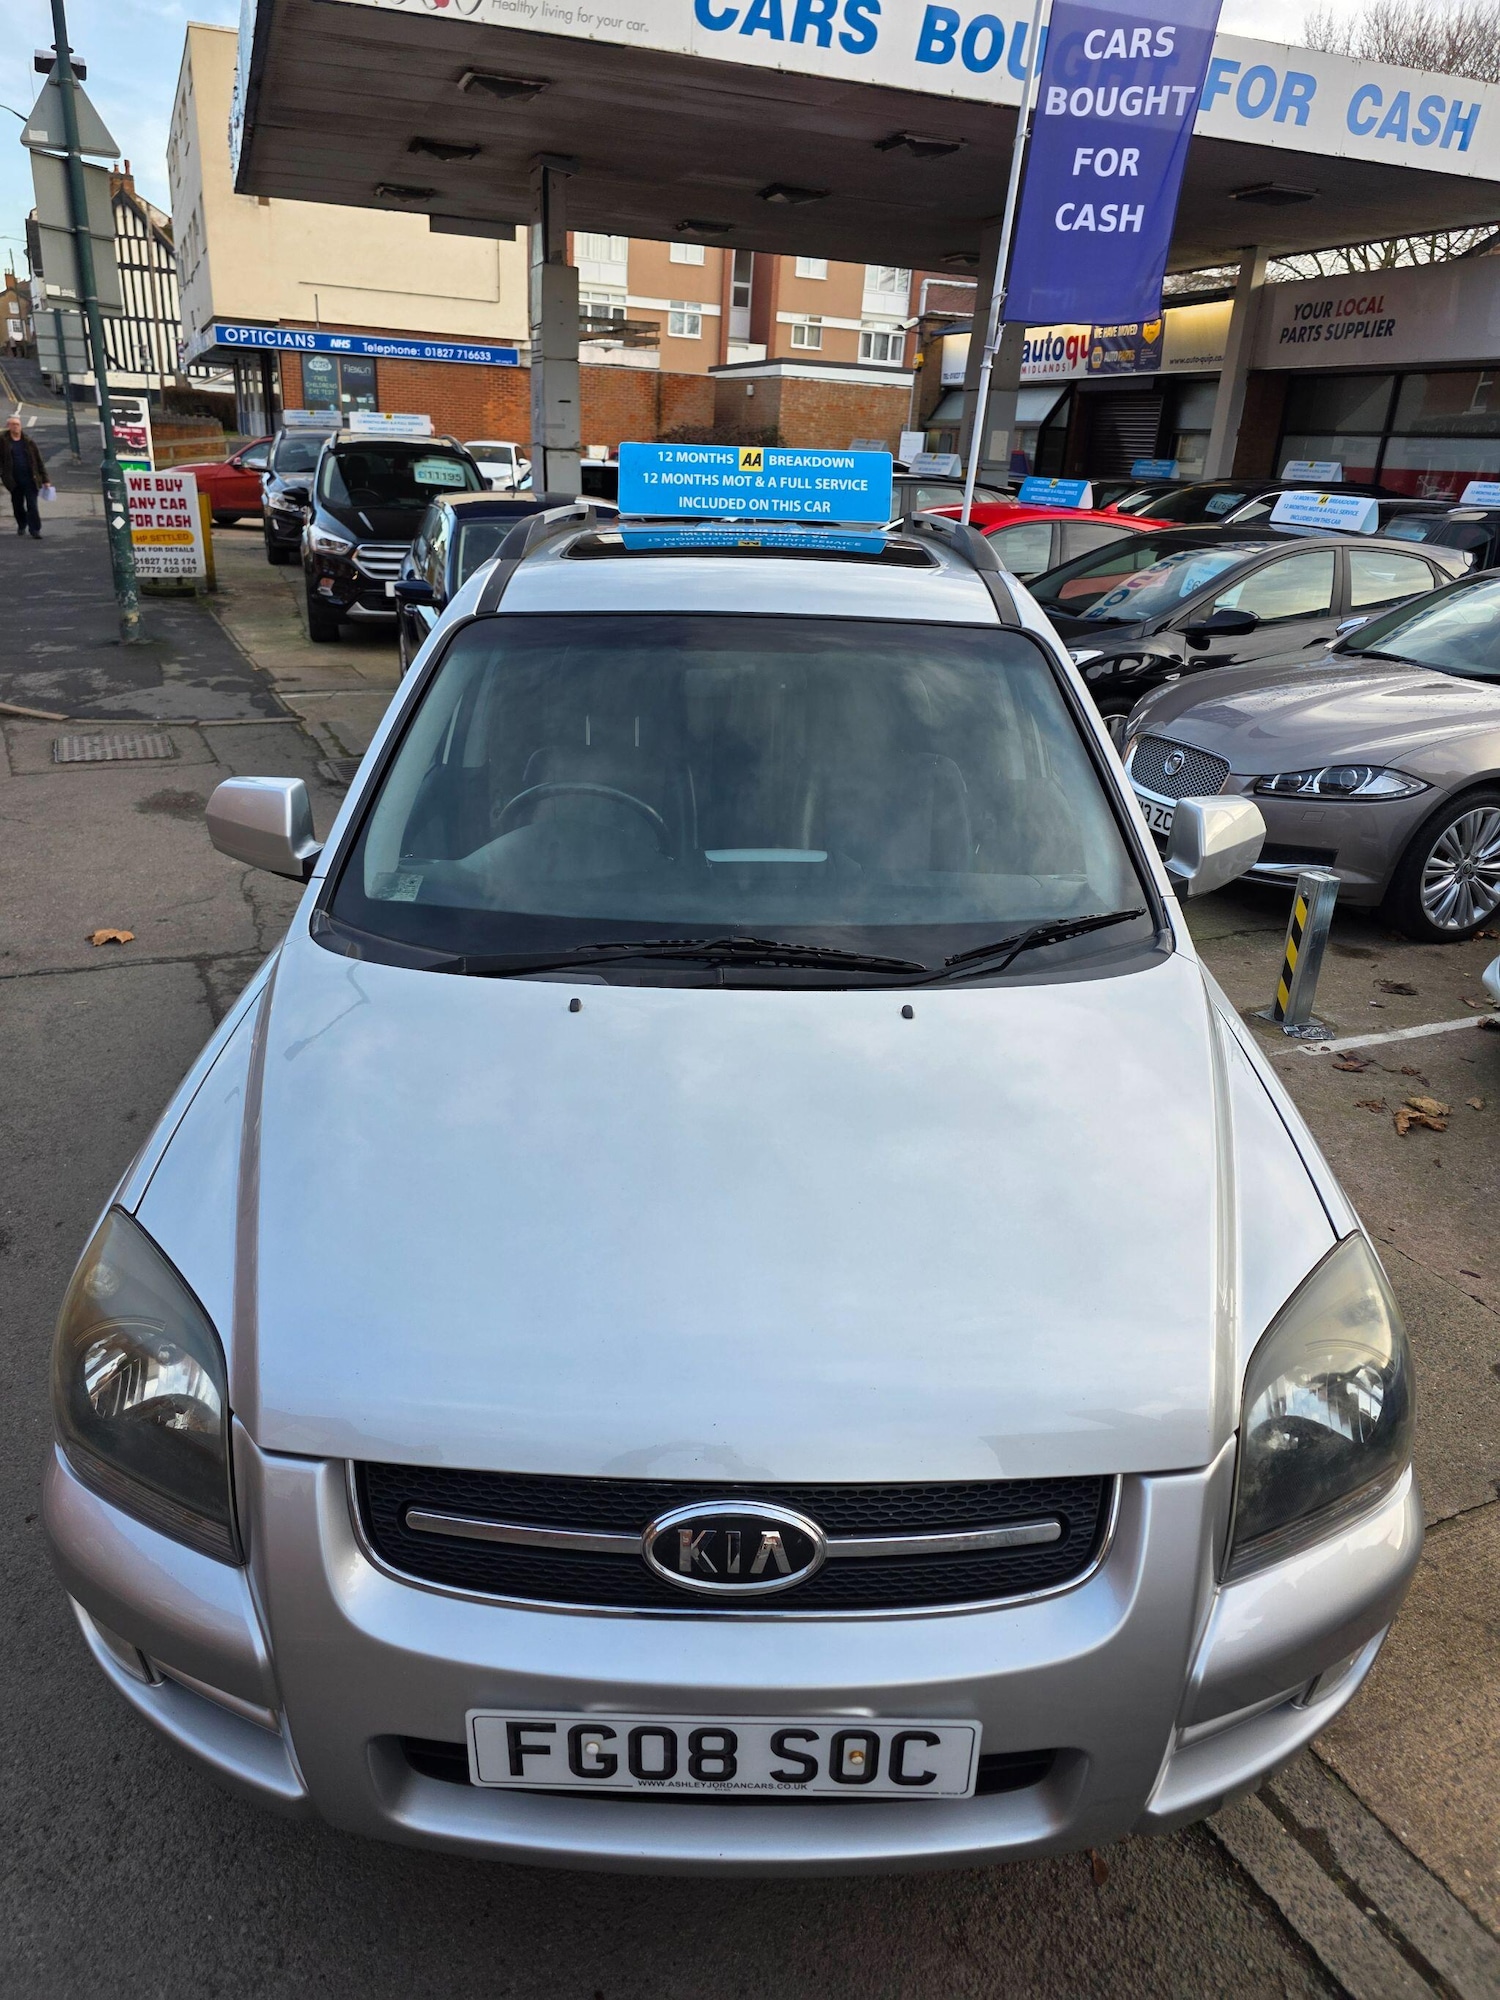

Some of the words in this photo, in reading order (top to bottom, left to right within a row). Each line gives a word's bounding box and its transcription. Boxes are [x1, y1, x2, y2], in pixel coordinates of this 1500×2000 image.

[491, 0, 538, 18] Healthy
[541, 1, 573, 24] living
[577, 6, 594, 23] for
[597, 15, 623, 28] your
[1084, 26, 1176, 60] CARS
[1045, 86, 1195, 116] BOUGHT
[1200, 57, 1317, 126] FOR
[1347, 84, 1481, 152] CASH
[1072, 148, 1140, 176] FOR
[1055, 203, 1144, 232] CASH
[1294, 301, 1333, 320] YOUR
[1335, 296, 1384, 317] LOCAL
[1094, 326, 1103, 338] WE
[1103, 325, 1118, 338] HAVE
[1118, 324, 1138, 336] MOVED
[1279, 325, 1322, 343] PARTS
[1324, 319, 1396, 340] SUPPLIER
[225, 328, 316, 348] OPTICIANS
[330, 338, 351, 349] NHS
[362, 342, 420, 355] Telephone:
[425, 347, 454, 358] 01827
[457, 349, 491, 361] 716633
[1021, 362, 1066, 374] MIDLANDS
[657, 452, 672, 462] 12
[676, 452, 734, 465] MONTHS
[742, 453, 762, 467] AA
[769, 455, 854, 468] BREAKDOWN
[129, 478, 151, 491] WE
[156, 479, 182, 492] BUY
[643, 472, 658, 484] 12
[661, 473, 719, 486] MONTHS
[722, 475, 752, 487] MOT
[755, 476, 765, 487] &
[768, 477, 777, 488] A
[780, 477, 811, 489] FULL
[815, 478, 868, 491] SERVICE
[129, 497, 156, 509] ANY
[160, 498, 187, 510] CAR
[678, 497, 746, 510] INCLUDED
[749, 499, 771, 511] ON
[772, 500, 800, 512] THIS
[804, 500, 831, 513] CAR
[1319, 496, 1329, 504] AA
[156, 515, 191, 527] CASH
[150, 533, 189, 541] SETTLED
[1153, 809, 1173, 831] ZC
[677, 1529, 792, 1574] KIA
[506, 1721, 738, 1780] FG08
[769, 1728, 941, 1786] SOC
[638, 1780, 808, 1790] WWW.ASHLEYJORDANCARS.CO.UK
